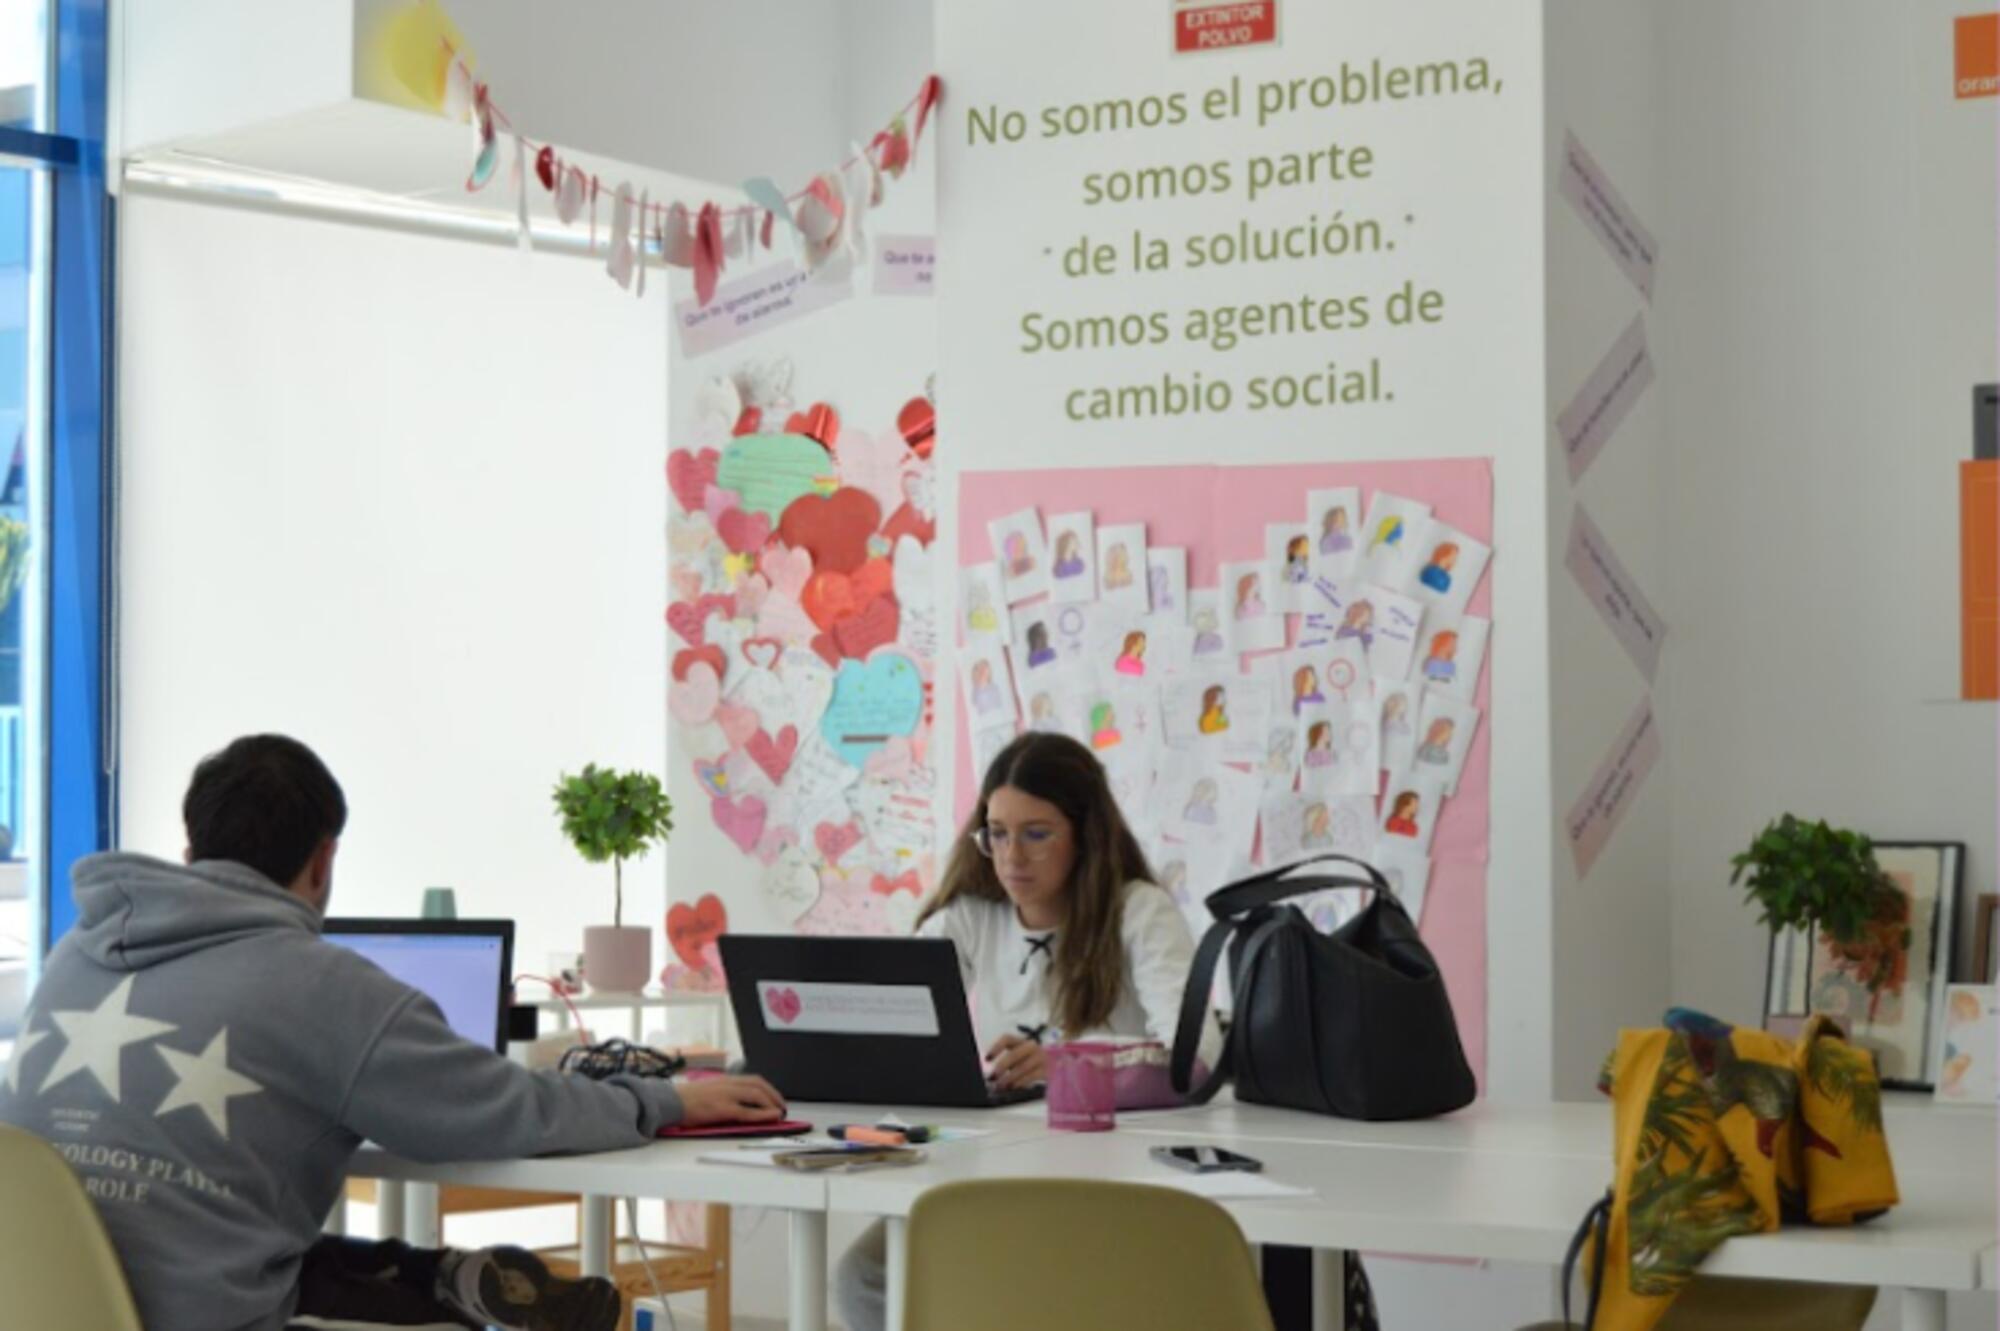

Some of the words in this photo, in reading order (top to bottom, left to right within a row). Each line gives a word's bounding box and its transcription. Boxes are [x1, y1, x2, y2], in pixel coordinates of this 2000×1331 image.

[1185, 4, 1264, 29] EXTINTOR
[1197, 24, 1252, 47] POLVO
[967, 105, 1027, 146] No
[1041, 92, 1188, 139] somos
[1202, 76, 1240, 121] el
[1258, 57, 1503, 127] problema,
[1083, 160, 1232, 206] somos
[1248, 143, 1374, 201] parte
[1063, 235, 1117, 278] de
[1133, 230, 1169, 273] la
[1185, 210, 1395, 268] solución.
[1021, 311, 1169, 354] Somos
[1184, 295, 1370, 351] agentes
[1385, 280, 1444, 326] de
[1064, 372, 1232, 422] cambio
[1247, 358, 1395, 410] social.
[53, 1143, 143, 1172] OLOGY
